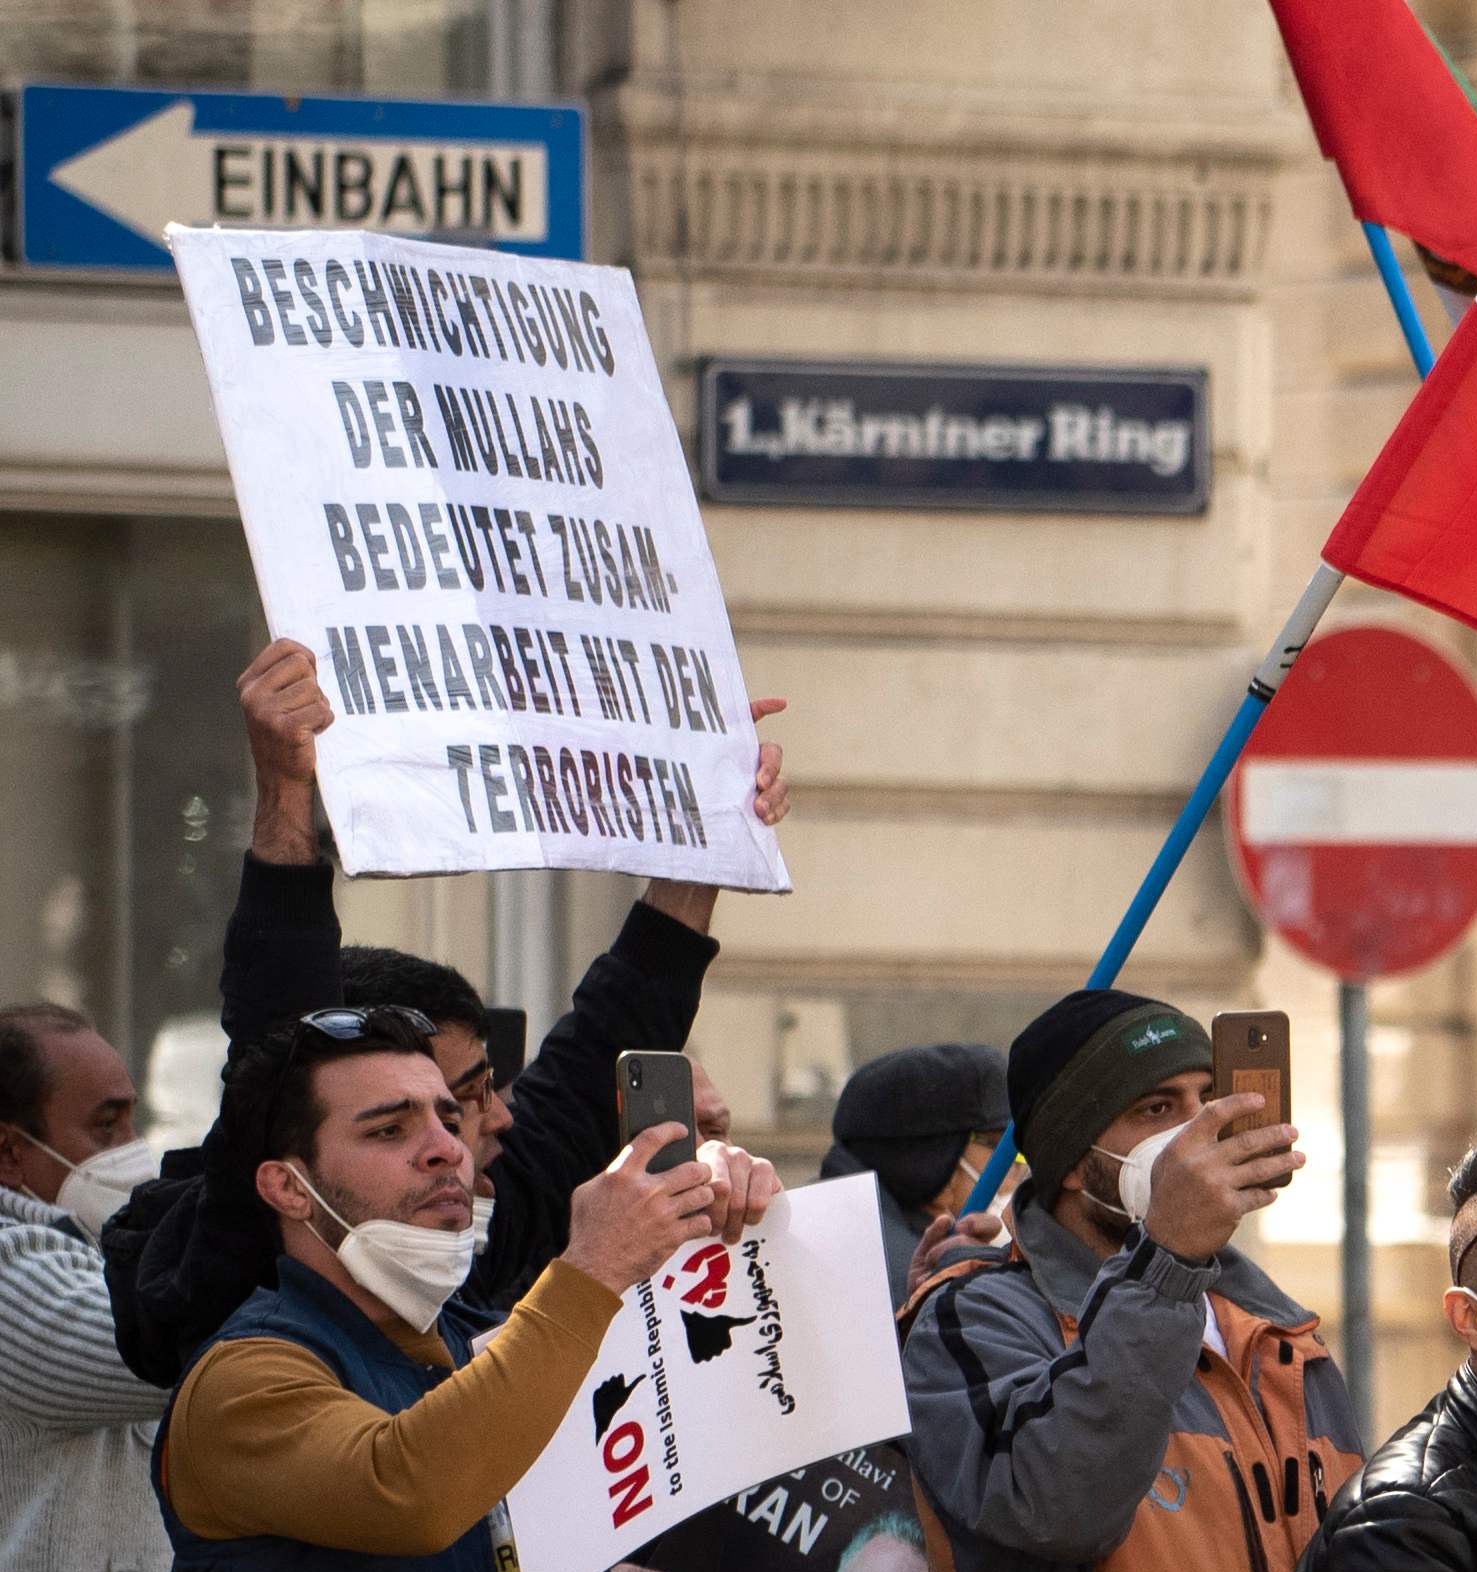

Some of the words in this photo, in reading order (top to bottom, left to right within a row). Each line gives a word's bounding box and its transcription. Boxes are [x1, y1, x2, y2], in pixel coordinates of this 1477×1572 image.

[212, 145, 523, 227] EINBAHN
[230, 257, 616, 377] BESCHWICHTIGUNG
[331, 381, 438, 470] DER
[434, 384, 605, 489] MULLAHS
[1047, 404, 1191, 478] Ring
[323, 501, 546, 595] BEDEUTET
[327, 624, 581, 718] MENARBEIT
[583, 635, 653, 725] MIT
[650, 643, 727, 735] DEN
[448, 745, 707, 849] TERRORISTEN
[636, 1279, 662, 1358] Republi
[650, 1357, 675, 1433] Islamic
[603, 1420, 653, 1529] NO
[663, 1432, 679, 1470] the
[669, 1472, 682, 1496] to
[822, 1478, 861, 1508] OF
